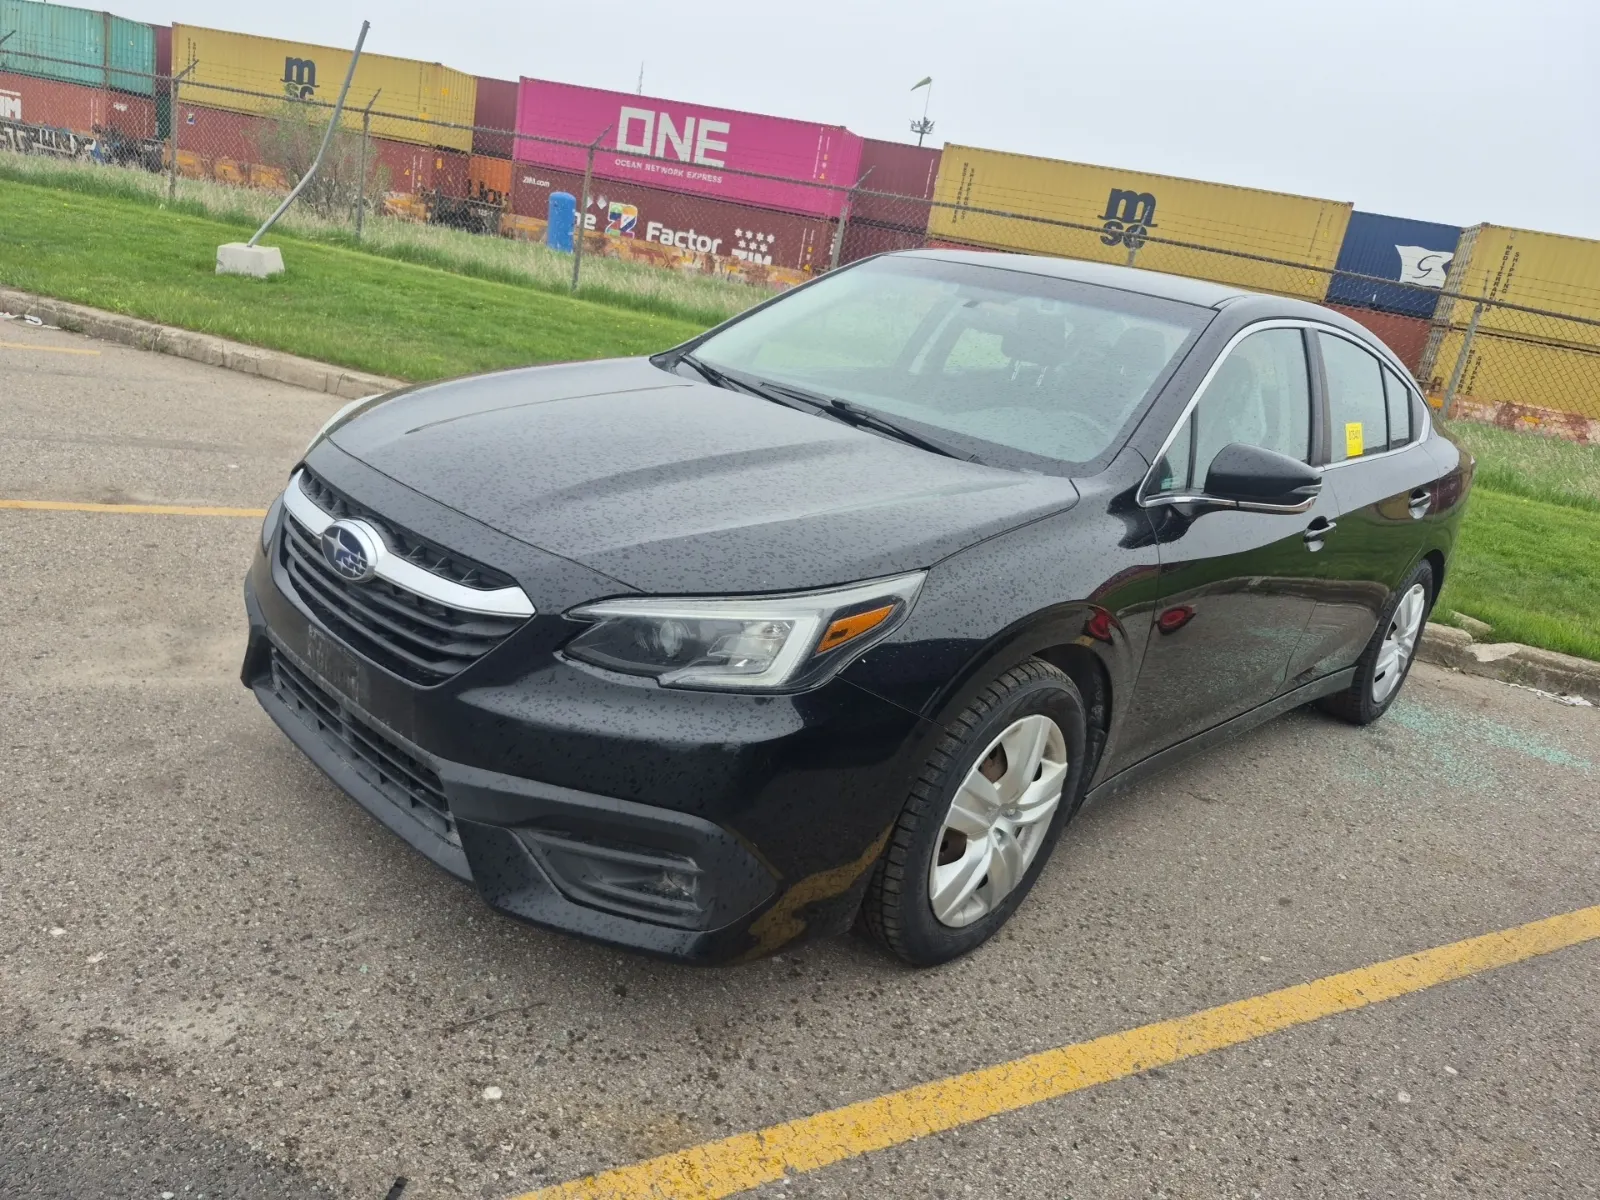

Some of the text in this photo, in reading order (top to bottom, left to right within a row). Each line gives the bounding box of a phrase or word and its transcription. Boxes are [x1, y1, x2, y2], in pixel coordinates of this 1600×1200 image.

[617, 105, 731, 168] ONE
[614, 159, 723, 184] OCEAN NETWORK EXPRESS
[645, 221, 723, 254] Factor
[1502, 251, 1520, 294] SHIPPING
